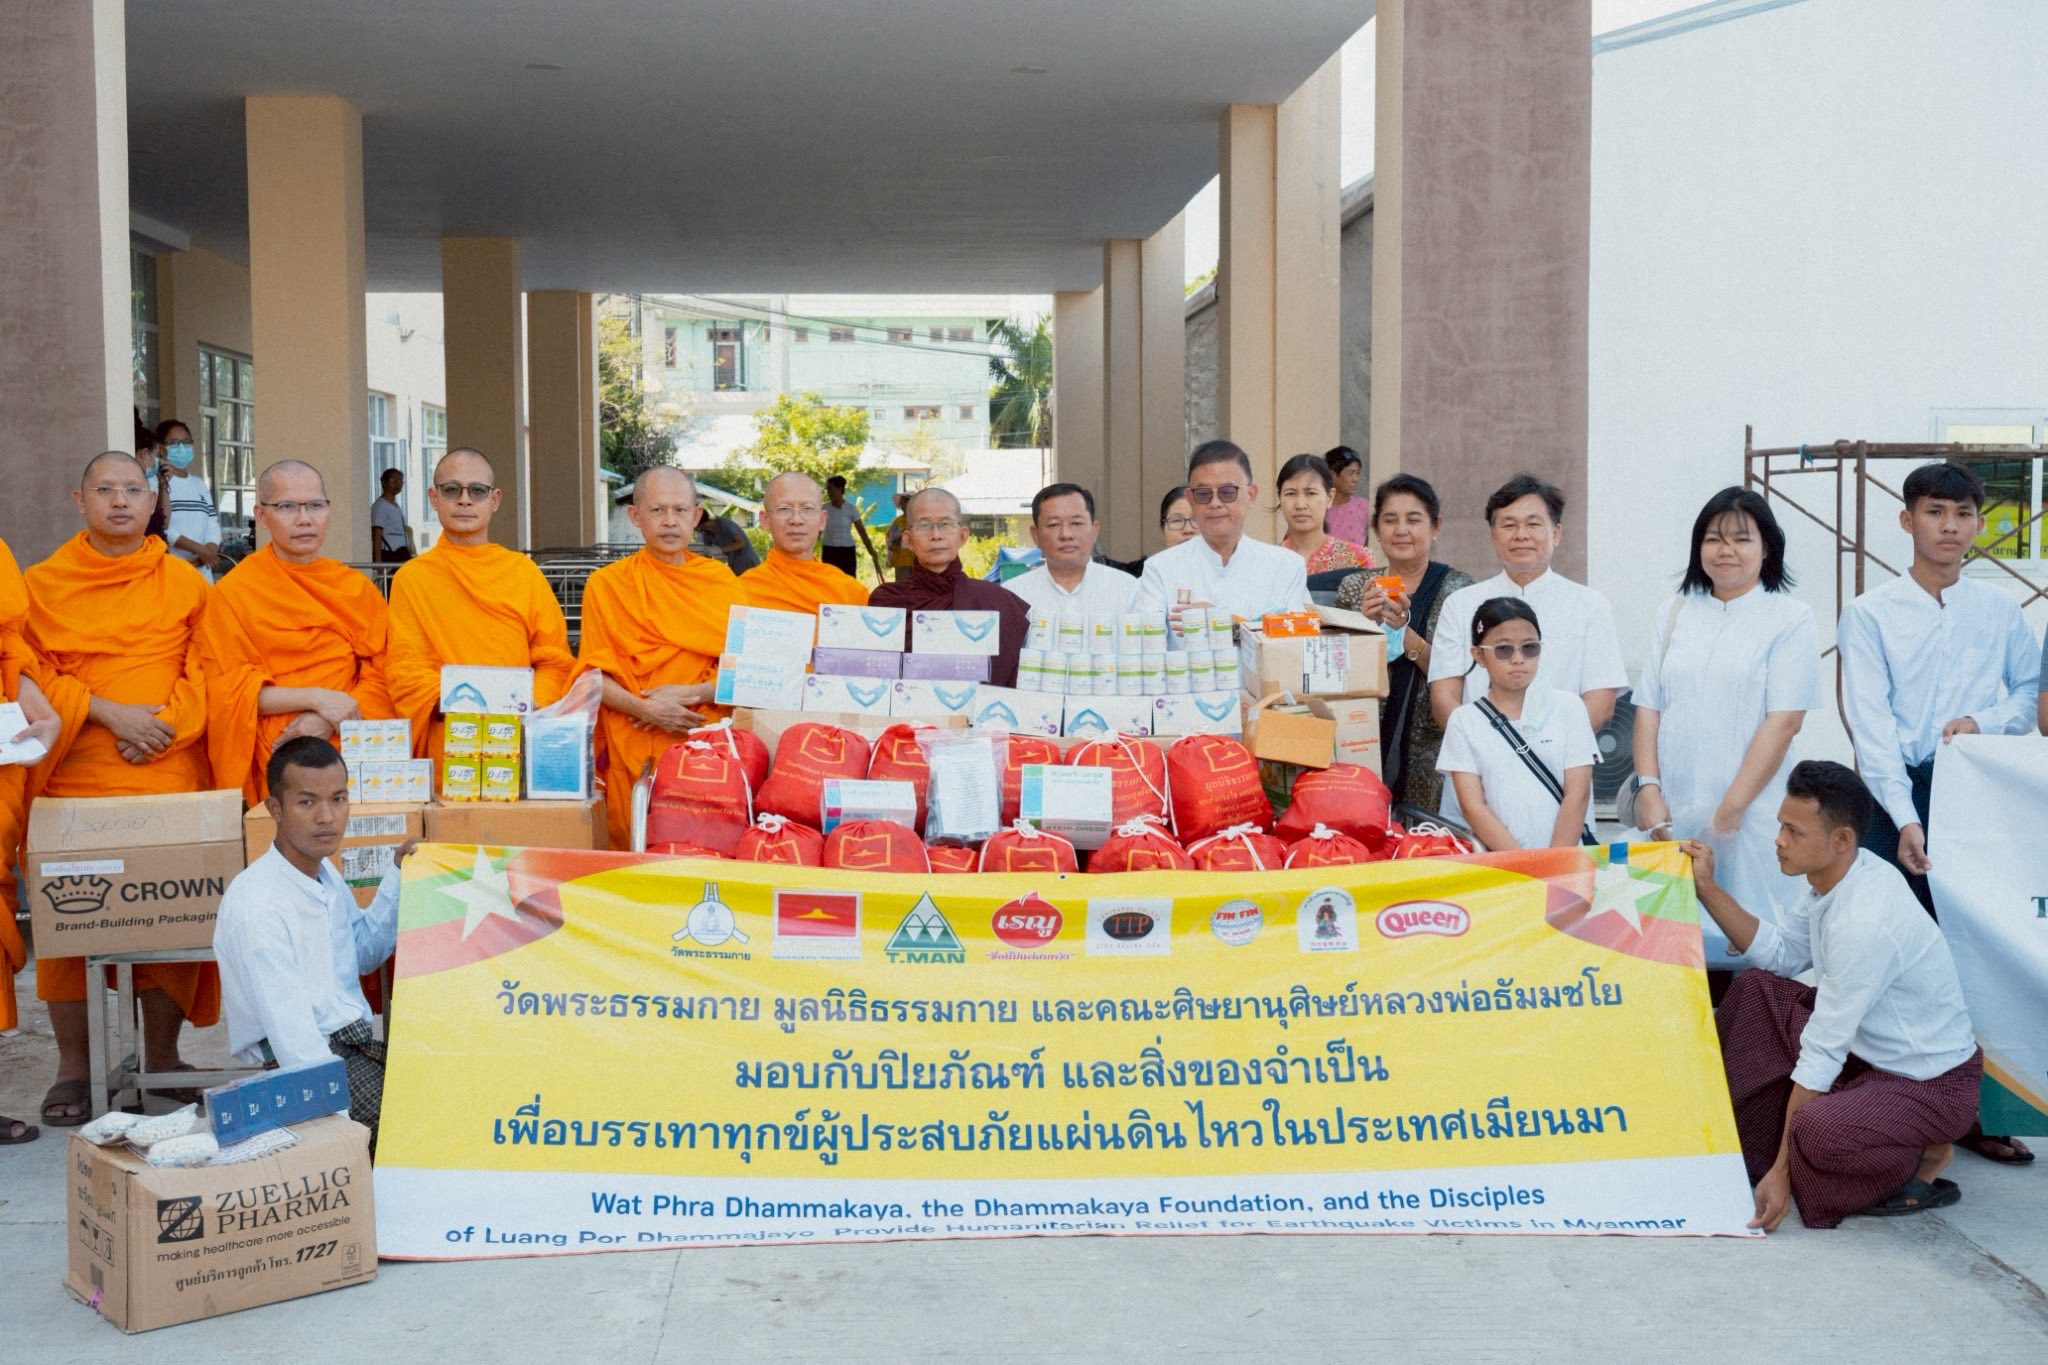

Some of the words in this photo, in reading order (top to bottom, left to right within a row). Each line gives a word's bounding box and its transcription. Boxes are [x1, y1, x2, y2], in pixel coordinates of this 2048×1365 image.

[120, 877, 225, 903] CROWN
[55, 916, 154, 932] Brand-Building
[158, 911, 219, 925] Packagin
[1385, 911, 1460, 931] Queen
[888, 952, 966, 965] T.MAN
[497, 980, 760, 1020] วัดพระธรรมกาย
[774, 988, 1017, 1033] มูลนิธิธรรมกาย
[1033, 966, 1622, 1029] และคณะศิษยานุศิษย์หลวงพ่อธัมมชโย
[736, 1046, 1046, 1090] มอบกับปิยภัณฑ์
[1063, 1035, 1390, 1089] และสิ่งของจำเป็น
[216, 1166, 351, 1213] ZUELLIG
[592, 1192, 642, 1216] Wat
[653, 1195, 715, 1217] Phra
[921, 1199, 964, 1217] the
[974, 1197, 1150, 1217] Dhammakaya
[1159, 1193, 1314, 1213] Foundation,
[1323, 1191, 1370, 1211] and
[1377, 1188, 1421, 1209] the
[1429, 1185, 1546, 1211] Disciples
[217, 1190, 350, 1234] PHARMA
[157, 1248, 201, 1262] making
[203, 1238, 263, 1255] healthcare
[266, 1230, 294, 1243] more
[297, 1217, 351, 1236] accessible
[445, 1226, 475, 1242] of
[485, 1228, 568, 1246] Luang
[578, 1230, 627, 1244] Por
[834, 1223, 936, 1235] Provide
[1136, 1219, 1211, 1230] Relief
[1219, 1219, 1258, 1230] for
[1267, 1218, 1416, 1231] Earthquake
[1425, 1218, 1524, 1229] Victims
[1531, 1218, 1556, 1229] in
[1563, 1216, 1688, 1231] Myanmar
[296, 1240, 338, 1263] 1727
